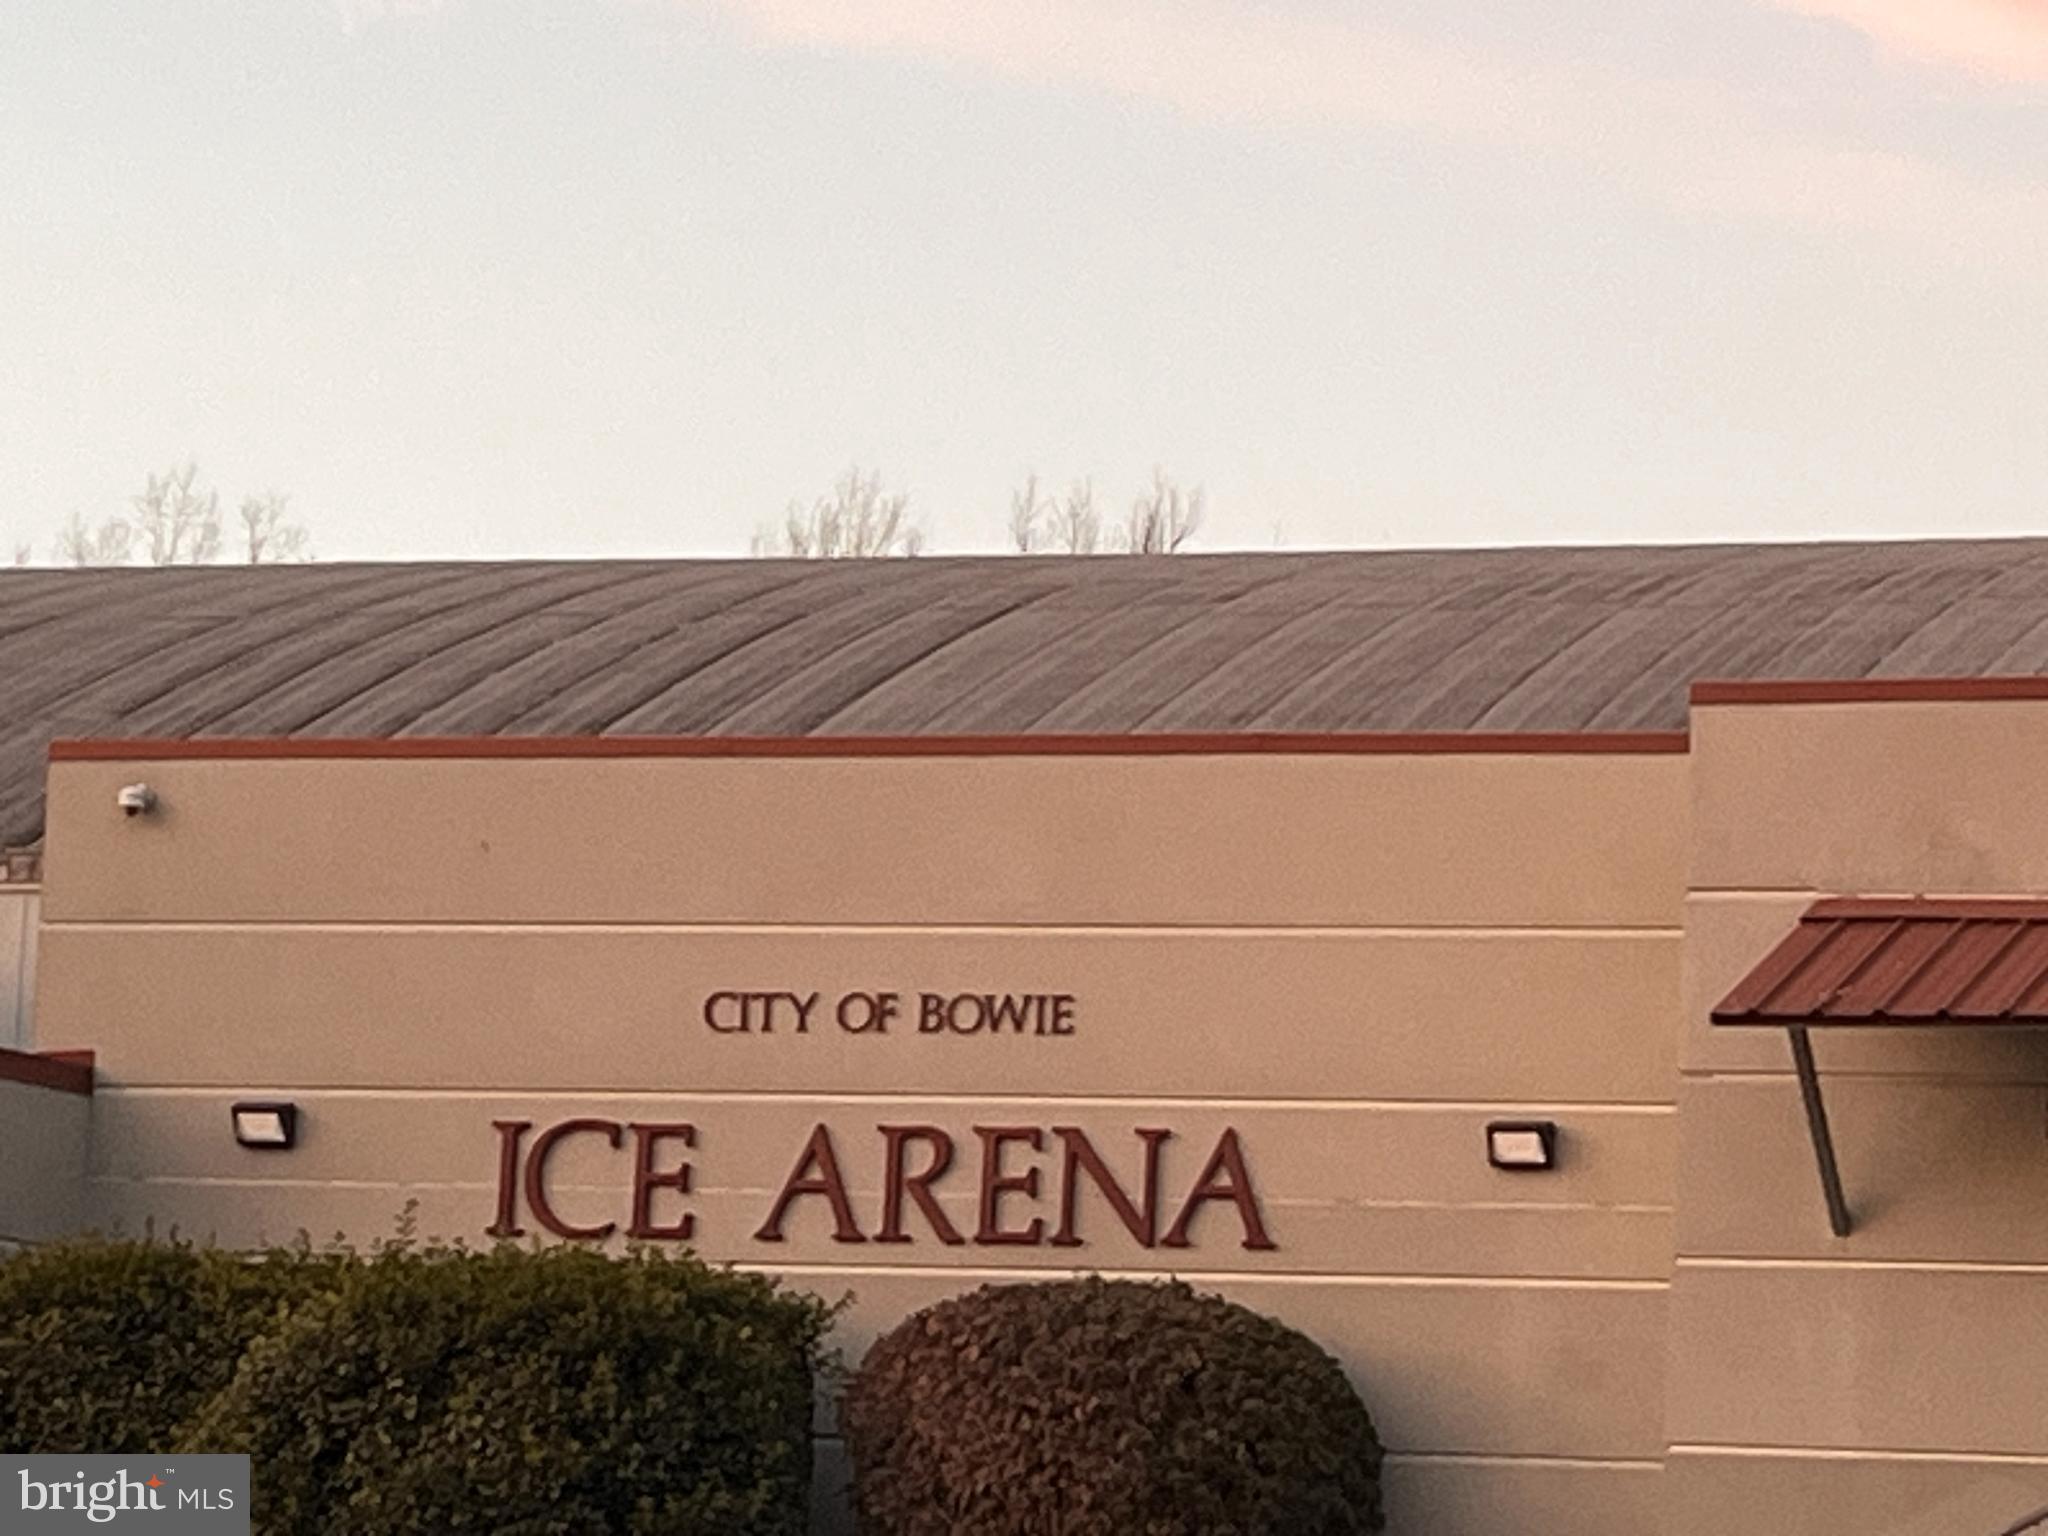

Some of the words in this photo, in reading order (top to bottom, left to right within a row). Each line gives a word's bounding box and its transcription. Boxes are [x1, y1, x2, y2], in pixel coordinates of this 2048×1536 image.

[704, 991, 819, 1034] CITY
[836, 991, 899, 1034] OF
[917, 992, 1075, 1036] BOWIE
[485, 1118, 697, 1241] ICE
[753, 1122, 1279, 1251] ARENA
